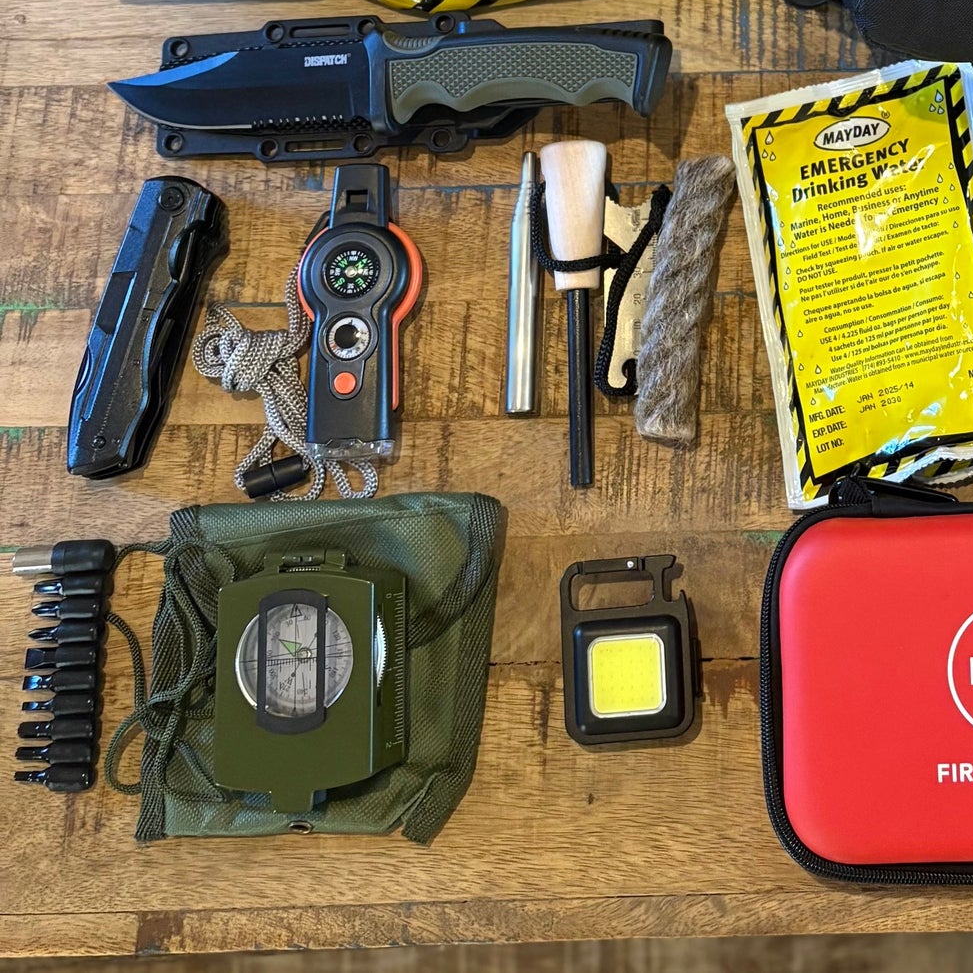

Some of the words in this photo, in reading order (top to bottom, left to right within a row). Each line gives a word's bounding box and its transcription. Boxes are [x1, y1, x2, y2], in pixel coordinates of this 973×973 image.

[823, 123, 880, 146] MAYDAY
[800, 138, 910, 180] EMERGENCY
[792, 172, 868, 204] Drinking
[883, 184, 906, 194] uses:
[903, 186, 939, 201] Anytime
[816, 442, 830, 453] LOT
